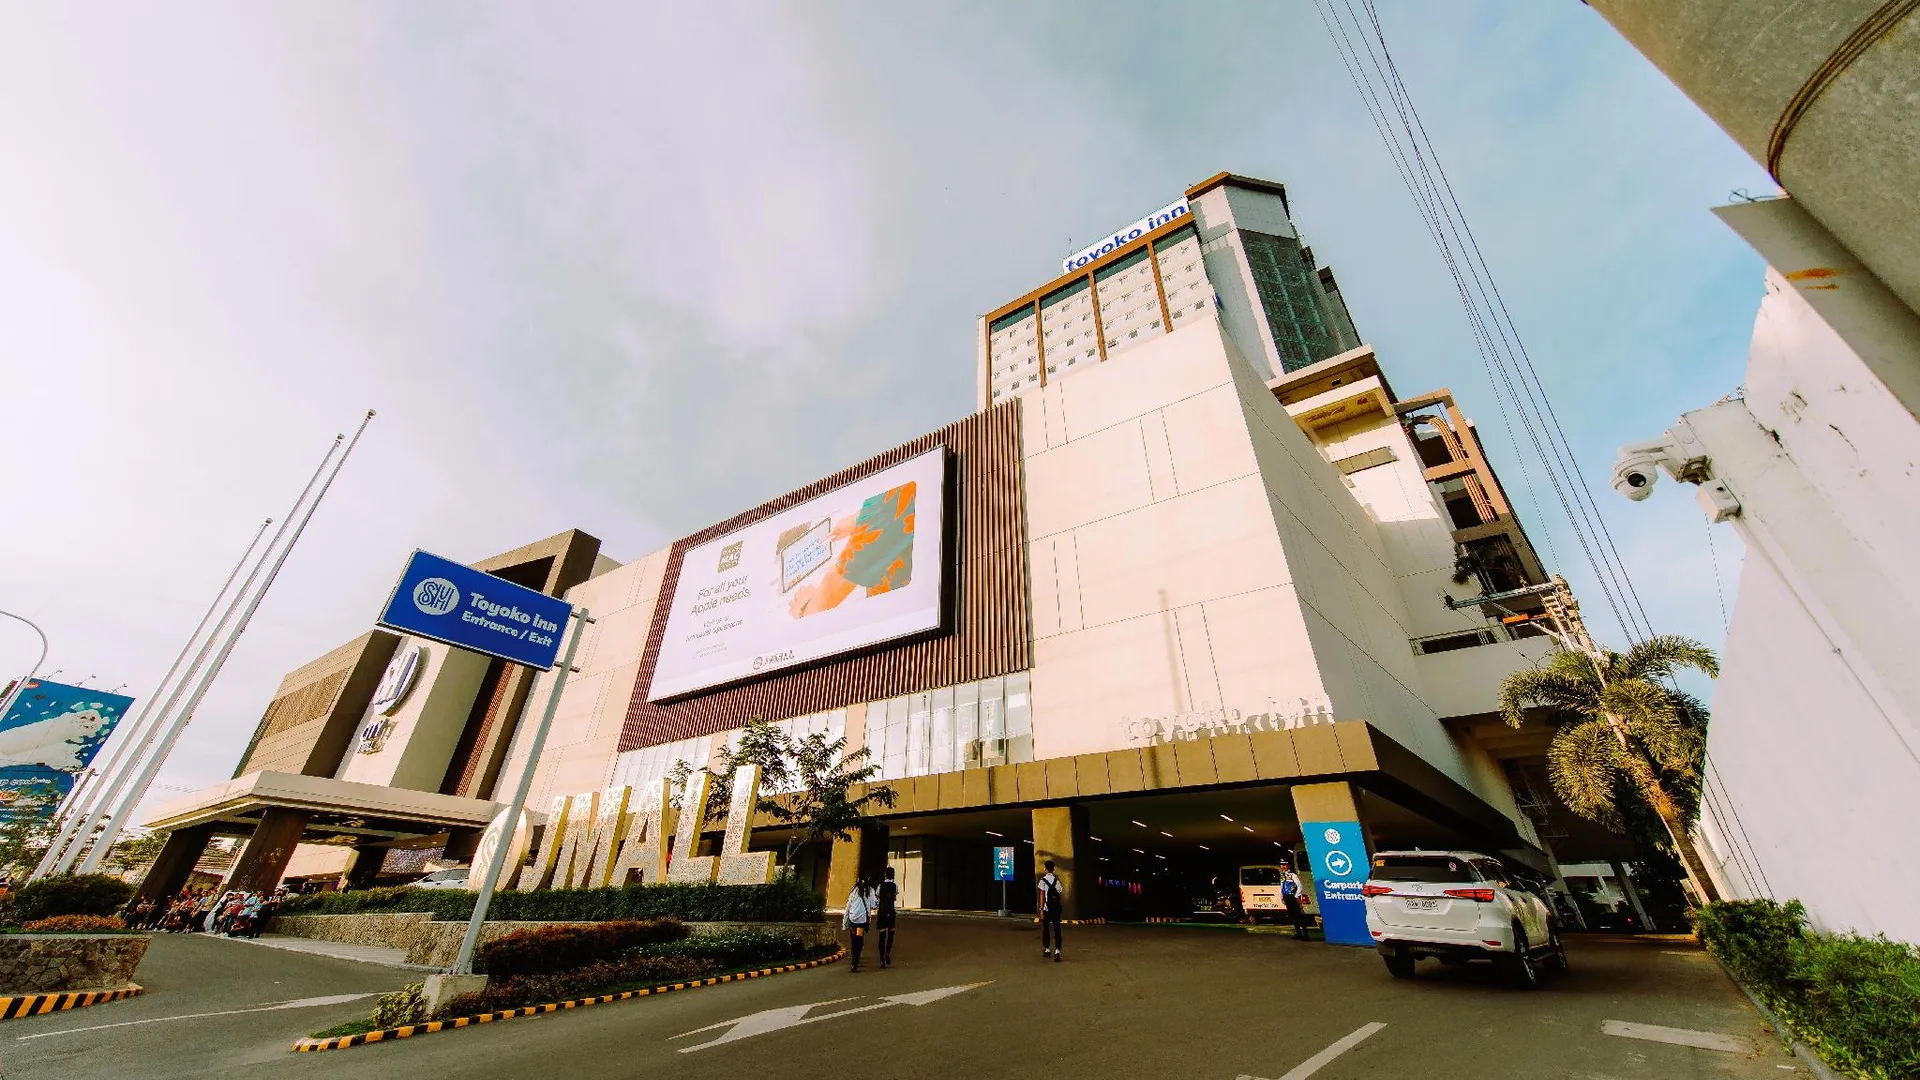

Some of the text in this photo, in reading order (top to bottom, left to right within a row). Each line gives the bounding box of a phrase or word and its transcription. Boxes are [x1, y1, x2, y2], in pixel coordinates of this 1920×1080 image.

[1065, 205, 1186, 272] toyoko inn
[714, 579, 727, 596] all
[725, 574, 749, 593] your
[469, 591, 530, 625] Toyoko
[690, 599, 719, 619] Apple
[461, 609, 555, 648] Entrance / Exit
[516, 764, 778, 892] JMALL
